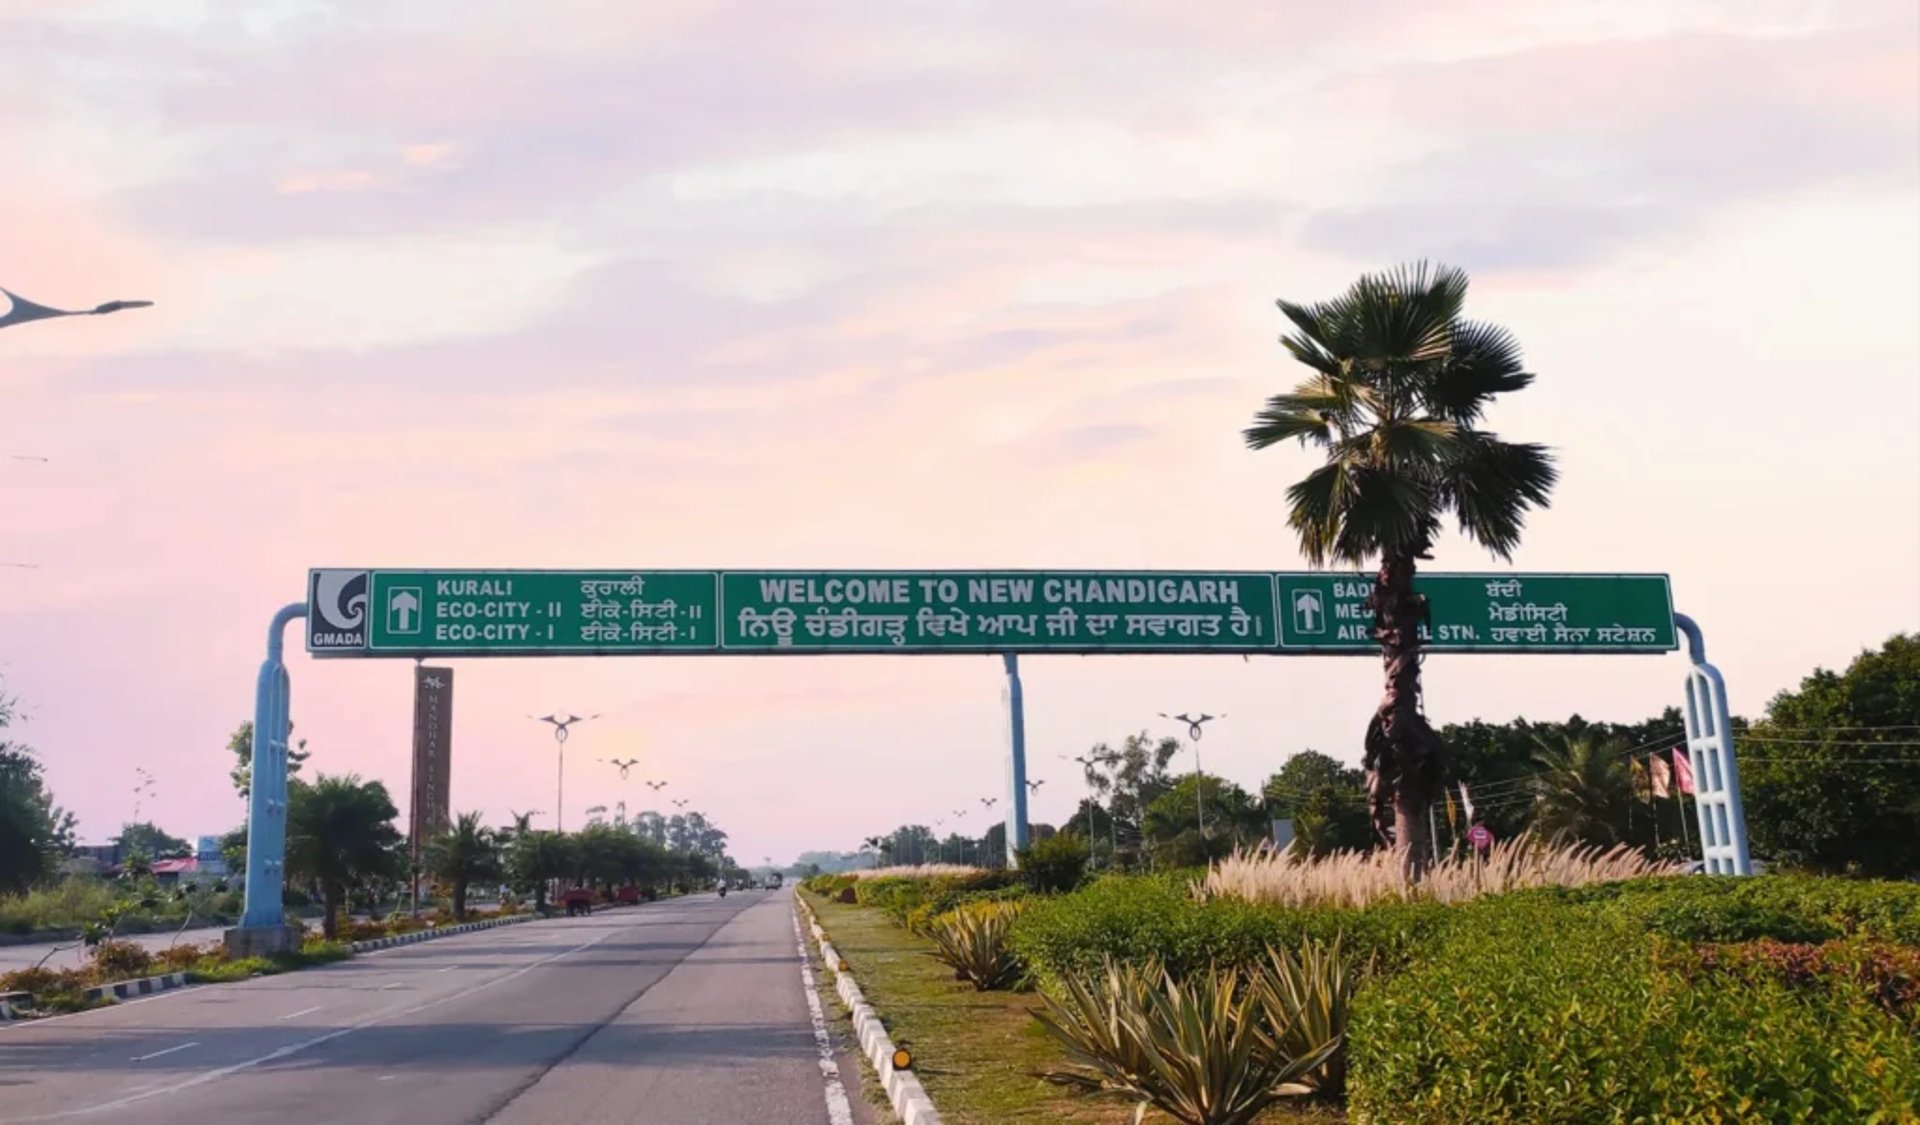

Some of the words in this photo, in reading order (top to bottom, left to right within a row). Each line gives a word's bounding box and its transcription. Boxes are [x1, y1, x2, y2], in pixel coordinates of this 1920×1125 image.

[437, 580, 512, 595] KURALI
[580, 575, 645, 598] ਕੁਰਾਲੀ
[759, 579, 910, 603] WELCOME
[918, 580, 959, 603] TO
[968, 580, 1034, 603] NEW
[1043, 579, 1239, 604] CHANDIGARH
[1333, 582, 1376, 598] BAD
[1485, 579, 1522, 598] ਬੱਦੀ
[436, 602, 530, 618] ECO-CITY
[548, 602, 562, 618] II
[580, 599, 678, 619] ਈਕੋ-ਸਿਟੀ
[1488, 602, 1568, 622] ਮੇਡੀਸਿਟੀ
[436, 624, 530, 640] ECO-CITY
[580, 622, 678, 641] ਈਕੋ-ਸਿਟੀ
[738, 607, 797, 647] ਨਿਊ
[804, 606, 908, 645] ਚੰਡੀਗੜ੍ਹ
[916, 607, 969, 637] ਵਿਖੇ
[977, 614, 1037, 636] ਆਪ
[1046, 607, 1078, 636] ਜੀ
[1086, 614, 1118, 637] ਦਾ
[1125, 614, 1223, 637] ਸਵਾਗਤ
[1337, 624, 1370, 640] AIR
[1438, 624, 1480, 640] STN.
[1491, 623, 1547, 642] ਹਵਾਈ
[1554, 622, 1591, 642] ਸੈਨਾ
[313, 633, 363, 646] GMADA
